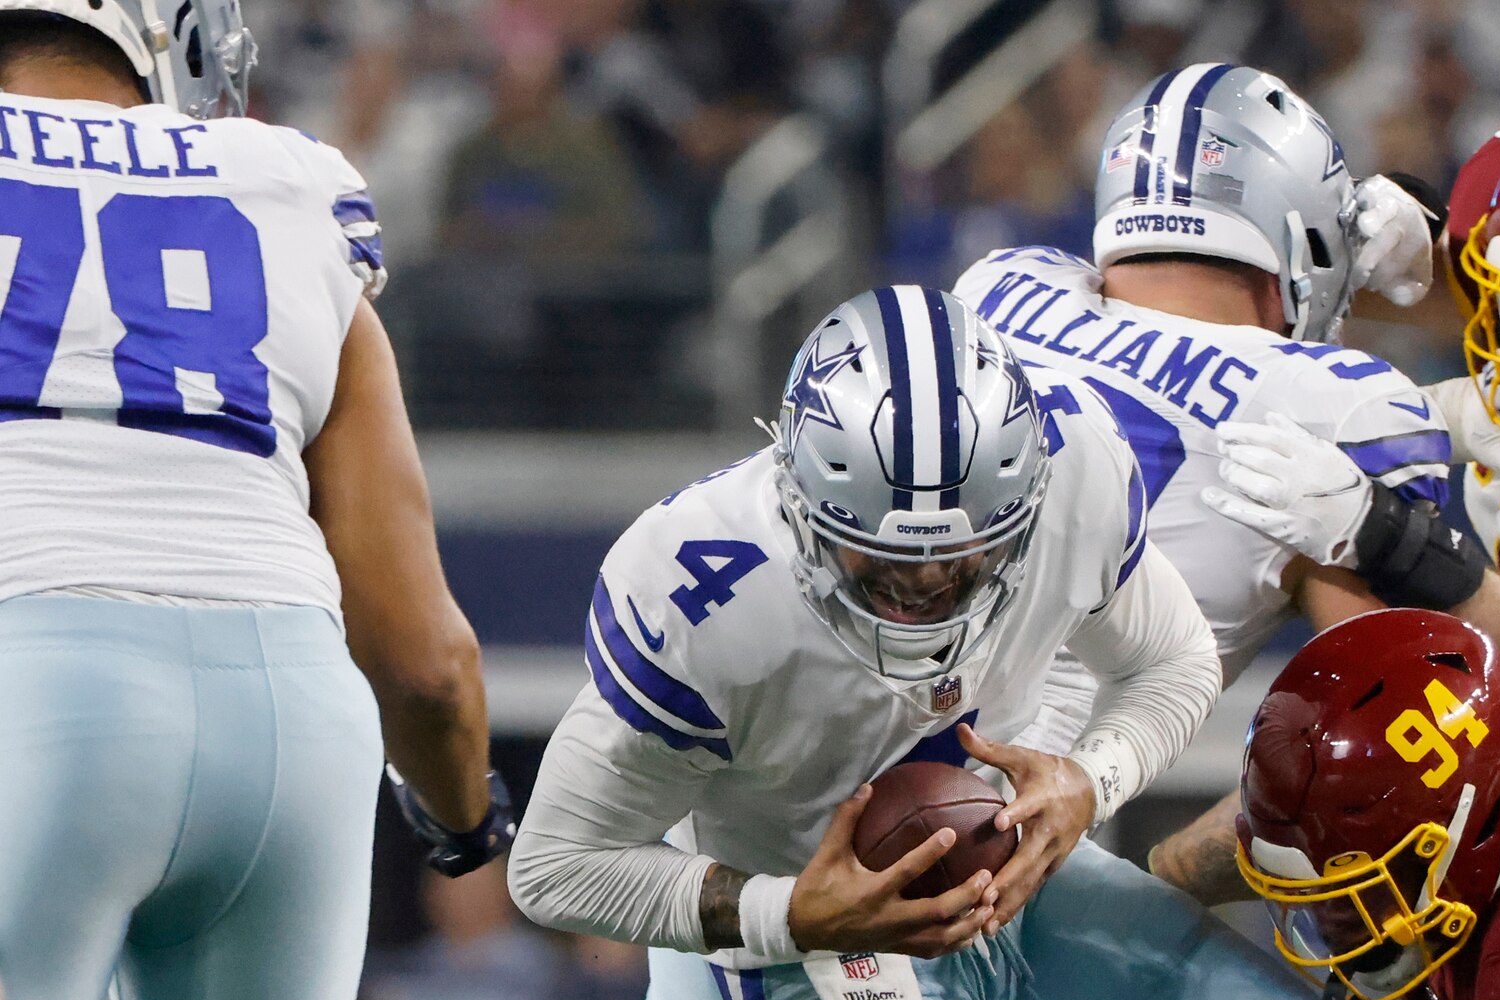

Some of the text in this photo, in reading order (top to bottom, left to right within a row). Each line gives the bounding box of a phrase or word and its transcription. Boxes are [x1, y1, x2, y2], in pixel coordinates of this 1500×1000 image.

[0, 105, 217, 178] TEELE
[1201, 150, 1222, 165] NFL
[1115, 214, 1206, 237] COWBOYS
[0, 177, 277, 458] 78
[975, 271, 1259, 430] WILLIAMS
[896, 524, 951, 535] COWBOYS
[668, 539, 770, 627] 4
[1385, 678, 1490, 789] 94
[843, 959, 877, 979] NFL
